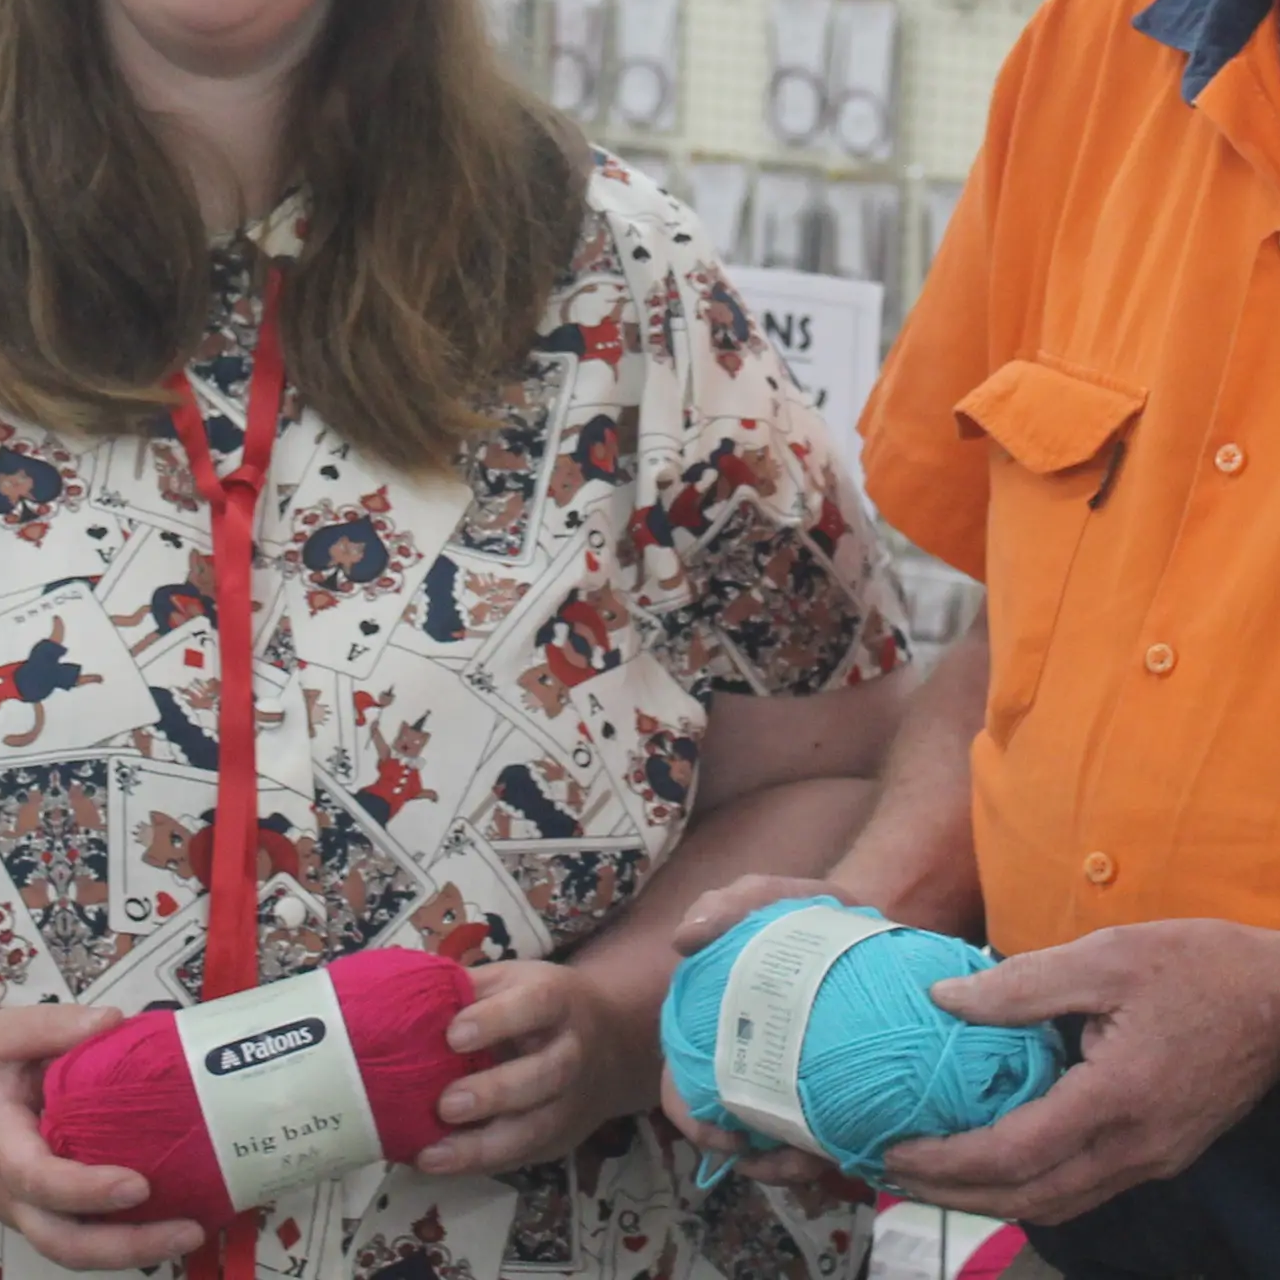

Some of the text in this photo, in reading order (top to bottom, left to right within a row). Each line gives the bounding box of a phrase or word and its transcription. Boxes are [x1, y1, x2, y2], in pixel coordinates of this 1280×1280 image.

[123, 895, 152, 922] Q
[240, 1026, 313, 1064] Patons
[233, 1112, 343, 1158] big baby
